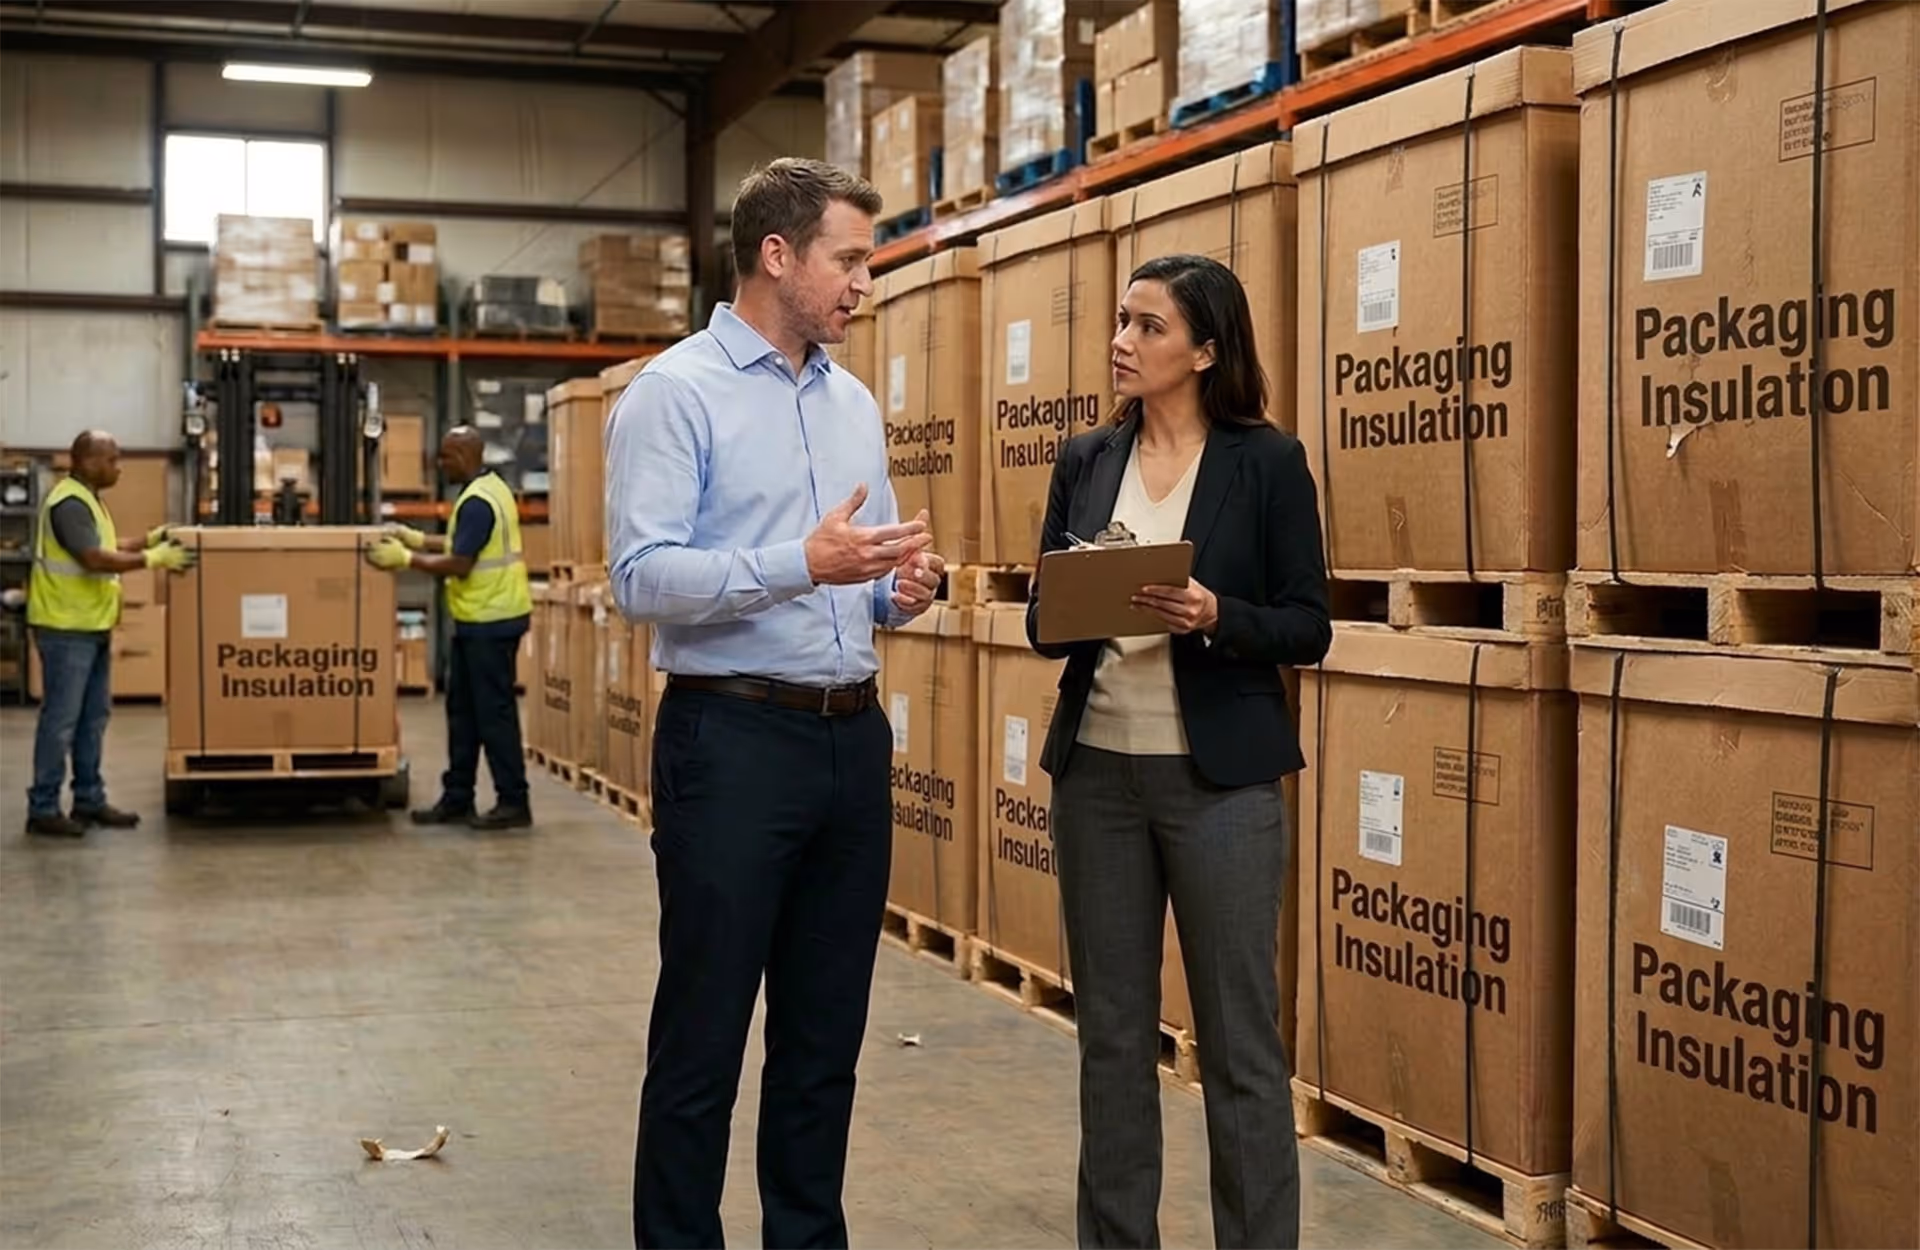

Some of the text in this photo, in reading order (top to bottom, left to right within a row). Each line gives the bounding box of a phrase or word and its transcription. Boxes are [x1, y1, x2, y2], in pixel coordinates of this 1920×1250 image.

[1335, 336, 1512, 396] Packaging
[1641, 358, 1889, 426] Insulation
[997, 388, 1098, 431] Packaging
[1340, 394, 1508, 449] Insulation
[217, 643, 378, 672] Packaging
[222, 674, 374, 698] Insulation
[891, 762, 954, 810] ackaging
[996, 788, 1053, 842] Packa
[1332, 867, 1511, 963] Packaging
[1335, 923, 1506, 1015] Insulation
[1633, 942, 1885, 1069] Packaging
[1637, 1010, 1877, 1134] Insulation
